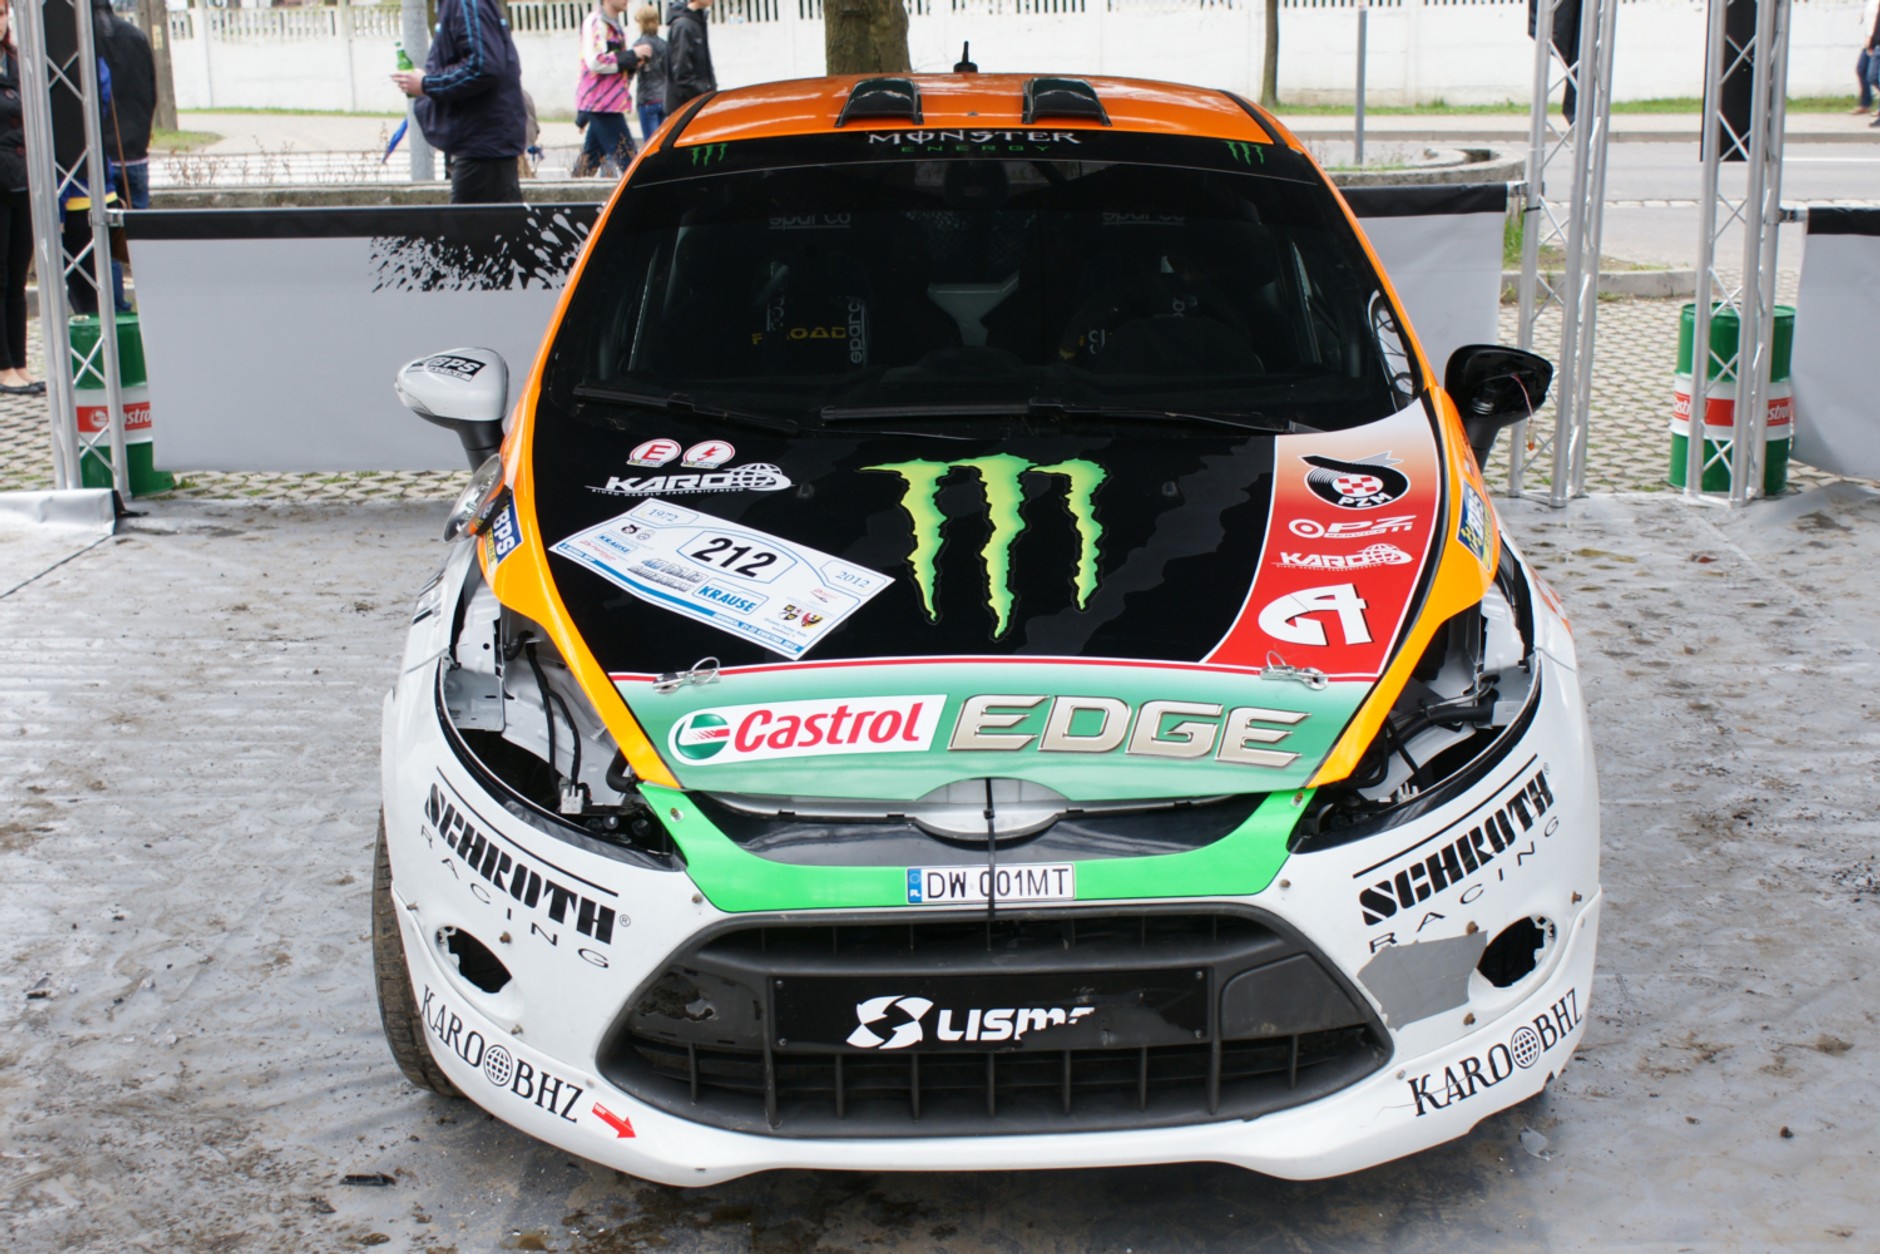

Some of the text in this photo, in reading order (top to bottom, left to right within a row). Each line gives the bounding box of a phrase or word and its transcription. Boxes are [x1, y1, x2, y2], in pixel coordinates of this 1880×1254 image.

[868, 130, 1082, 145] MONSTER
[901, 145, 1051, 153] ENERGY
[641, 444, 672, 461] E
[605, 474, 733, 493] KARO
[1338, 492, 1394, 508] PZM
[493, 508, 516, 556] BPS
[599, 535, 632, 554] KRAUSE
[691, 538, 777, 578] 212
[1279, 551, 1366, 568] KARO
[835, 570, 870, 589] 2012
[698, 583, 757, 614] KRAUSE
[734, 694, 1310, 768] Castrol EDGE
[1359, 769, 1555, 927] SCHROTH
[425, 782, 616, 946] SCHROTH
[421, 824, 610, 969] RACING
[927, 868, 1069, 899] DW 001MT
[1369, 815, 1560, 954] RACING
[422, 984, 584, 1124] KARO BHZ
[1407, 987, 1583, 1117] KARO BHZ
